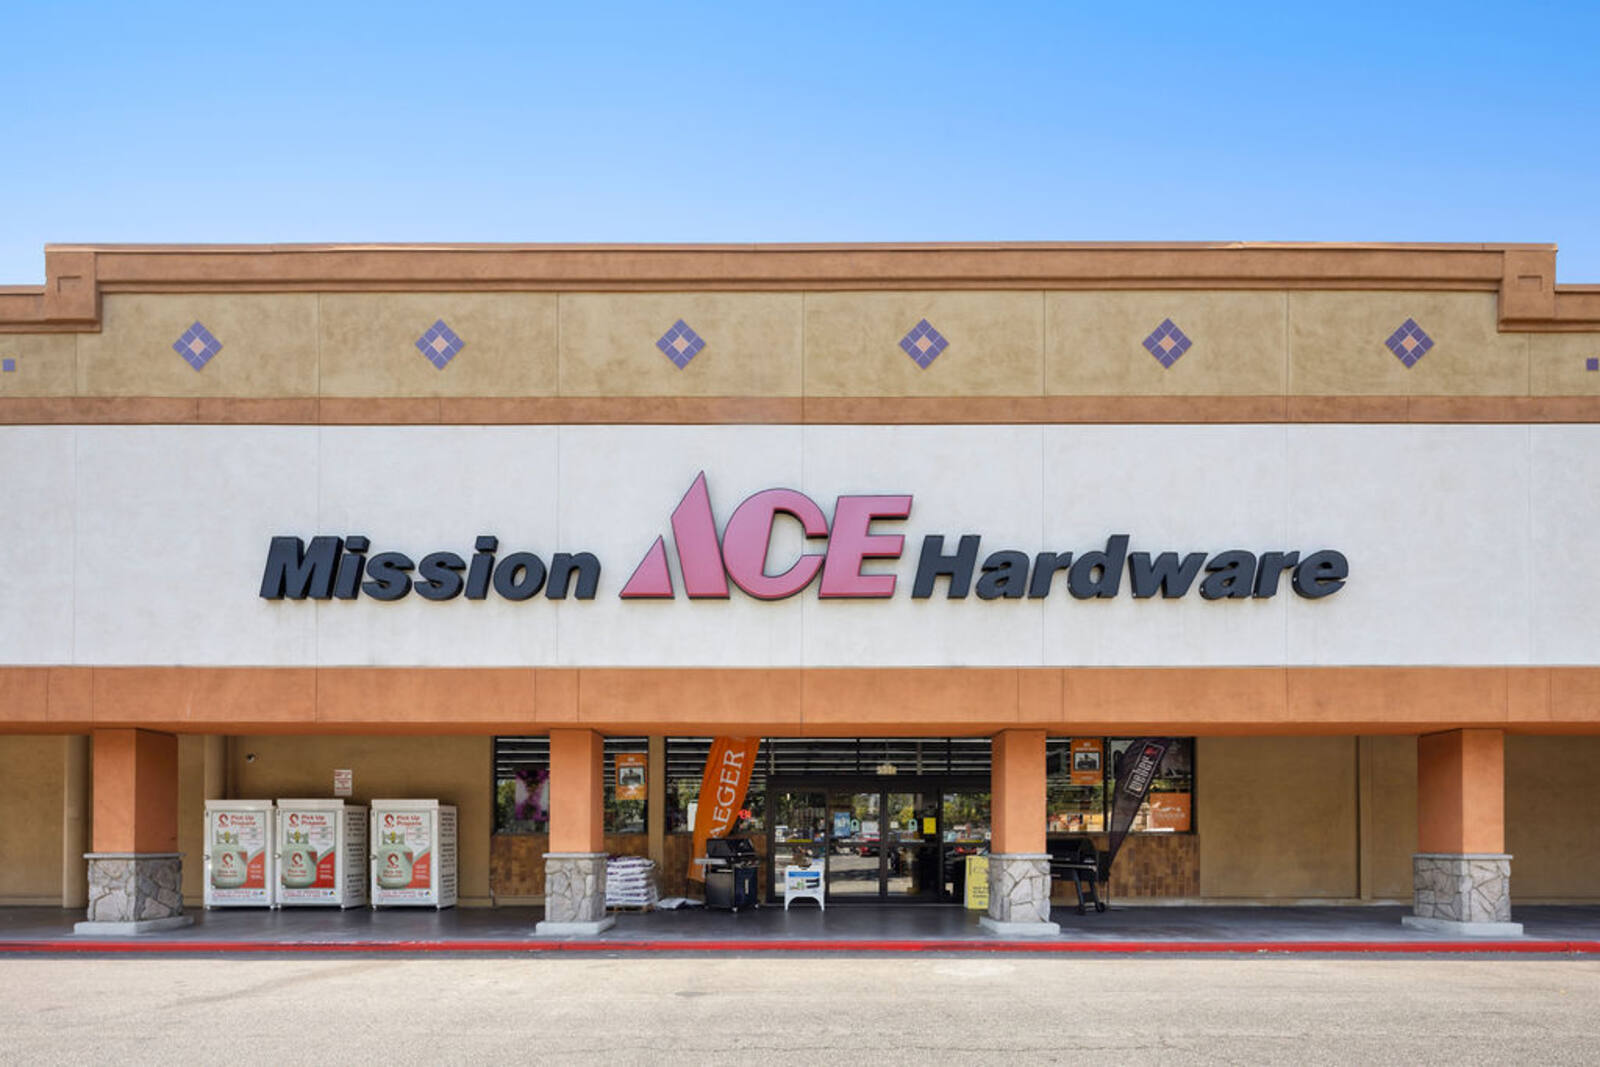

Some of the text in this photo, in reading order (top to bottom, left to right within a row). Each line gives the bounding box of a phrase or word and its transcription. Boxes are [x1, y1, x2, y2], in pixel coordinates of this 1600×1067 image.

[259, 470, 1350, 601] Mission ACE Hardware
